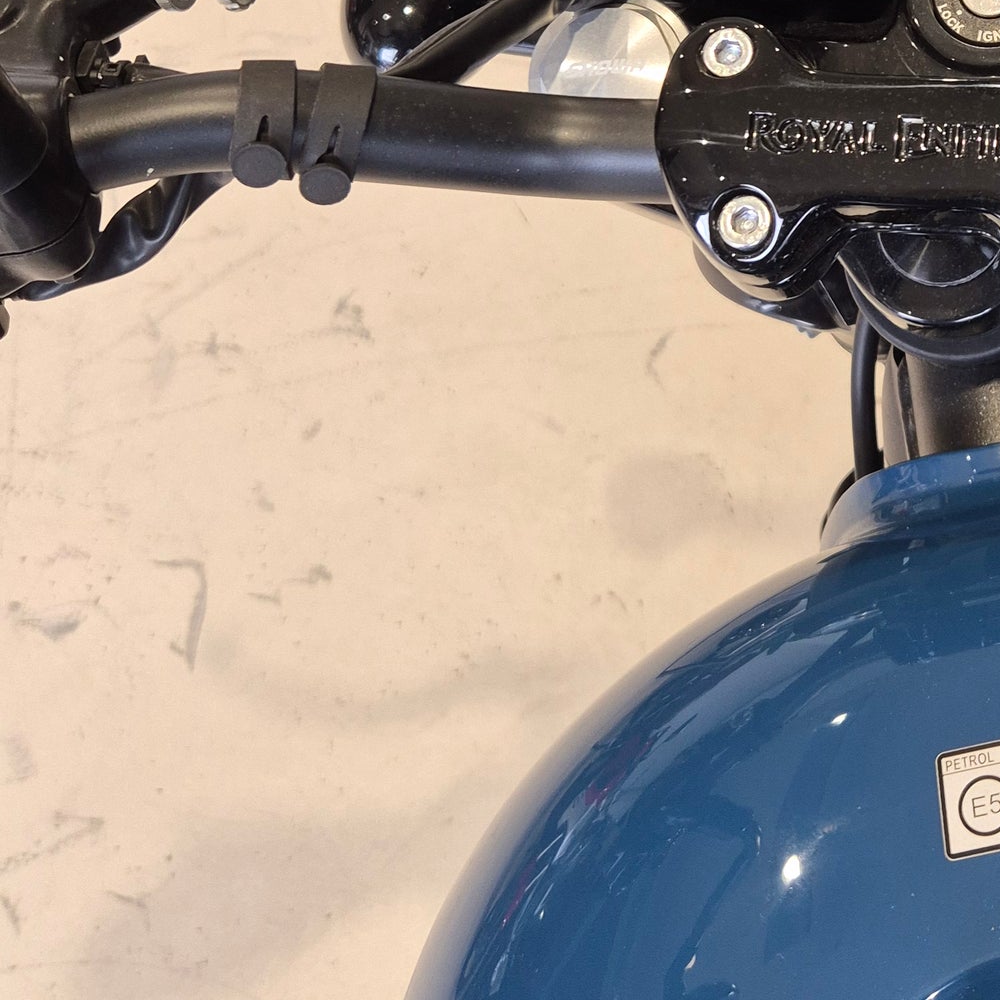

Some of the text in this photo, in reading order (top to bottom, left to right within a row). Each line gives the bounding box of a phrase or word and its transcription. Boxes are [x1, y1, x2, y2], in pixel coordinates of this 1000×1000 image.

[938, 3, 965, 34] LOCK
[744, 111, 887, 155] ROYAL
[945, 752, 994, 772] PETROL
